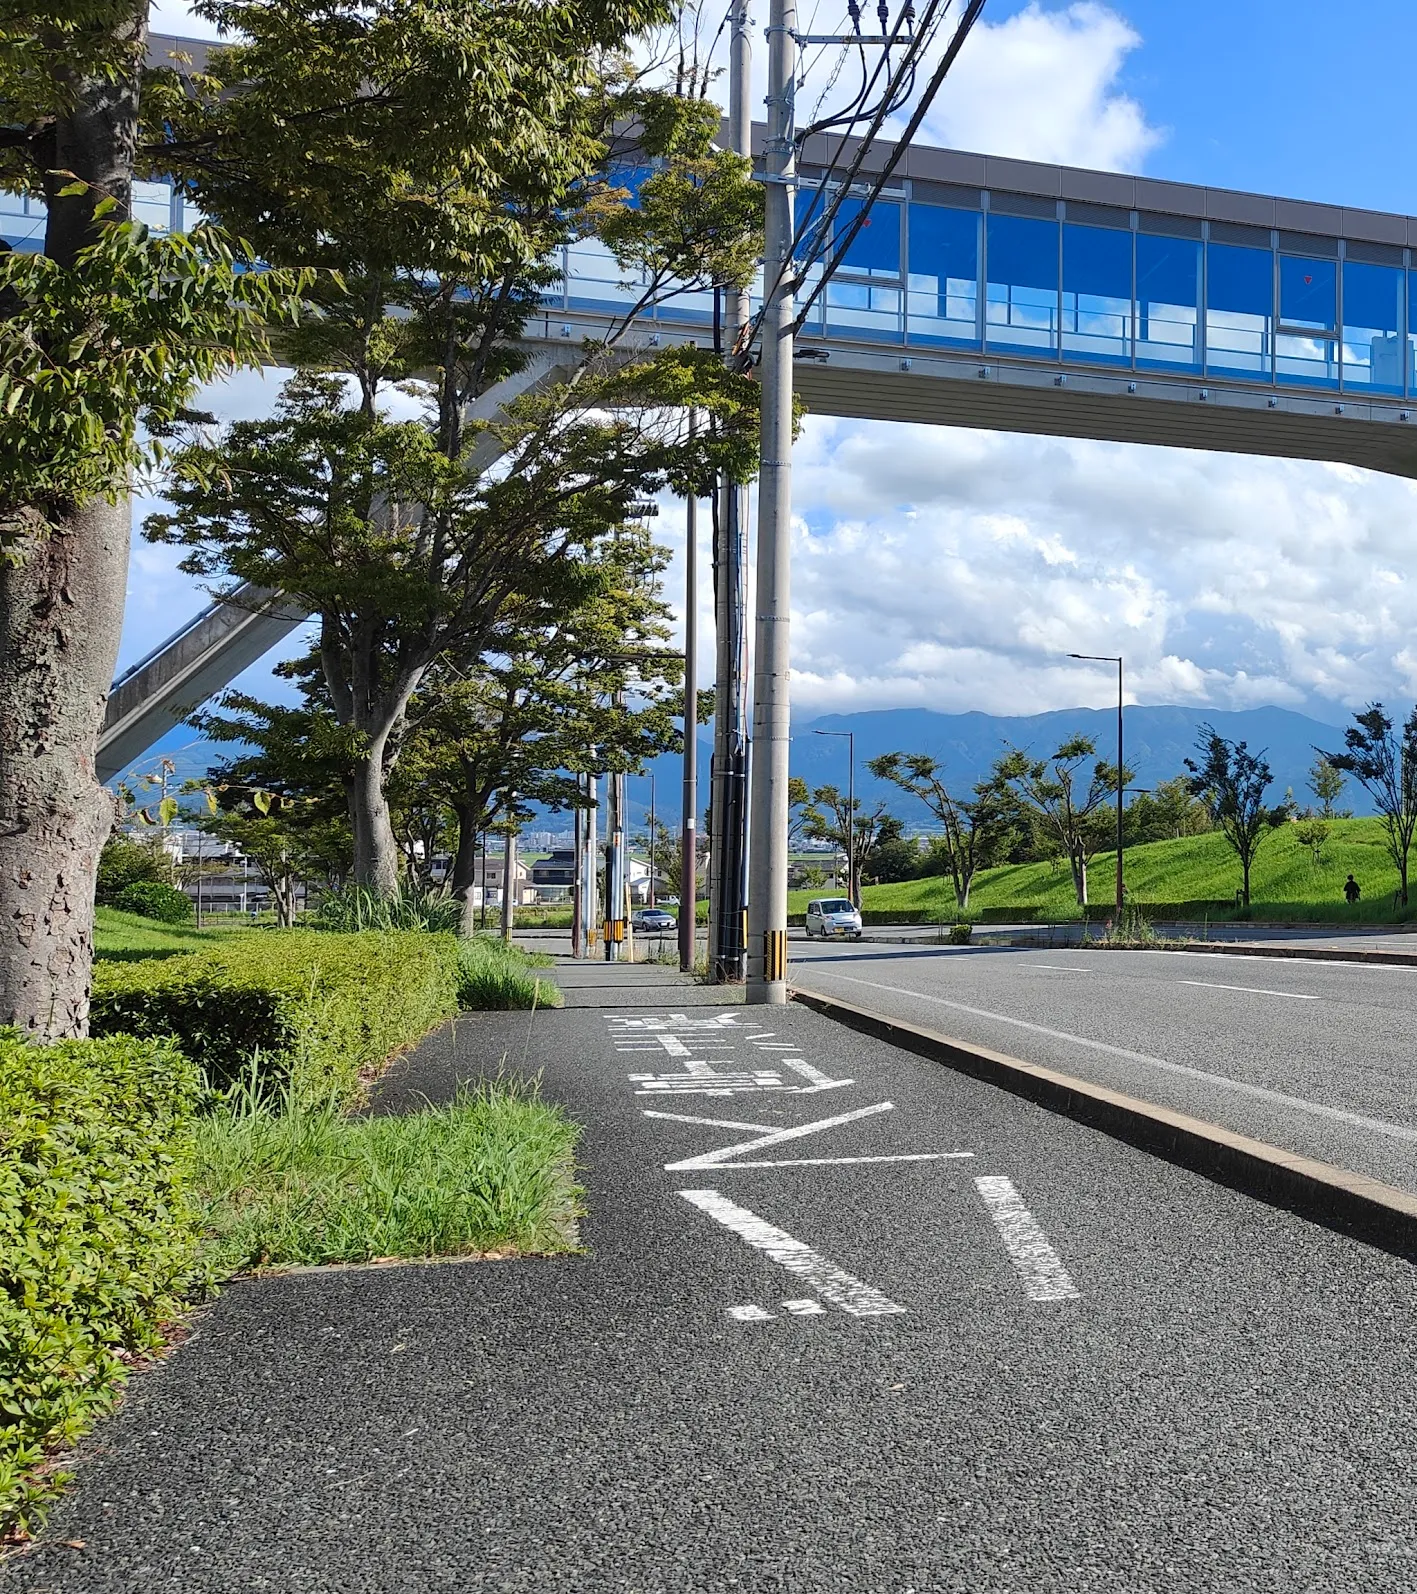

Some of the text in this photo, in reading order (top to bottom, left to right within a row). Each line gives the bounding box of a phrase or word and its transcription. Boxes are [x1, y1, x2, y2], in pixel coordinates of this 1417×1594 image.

[603, 1013, 1081, 1321] バス停注意
